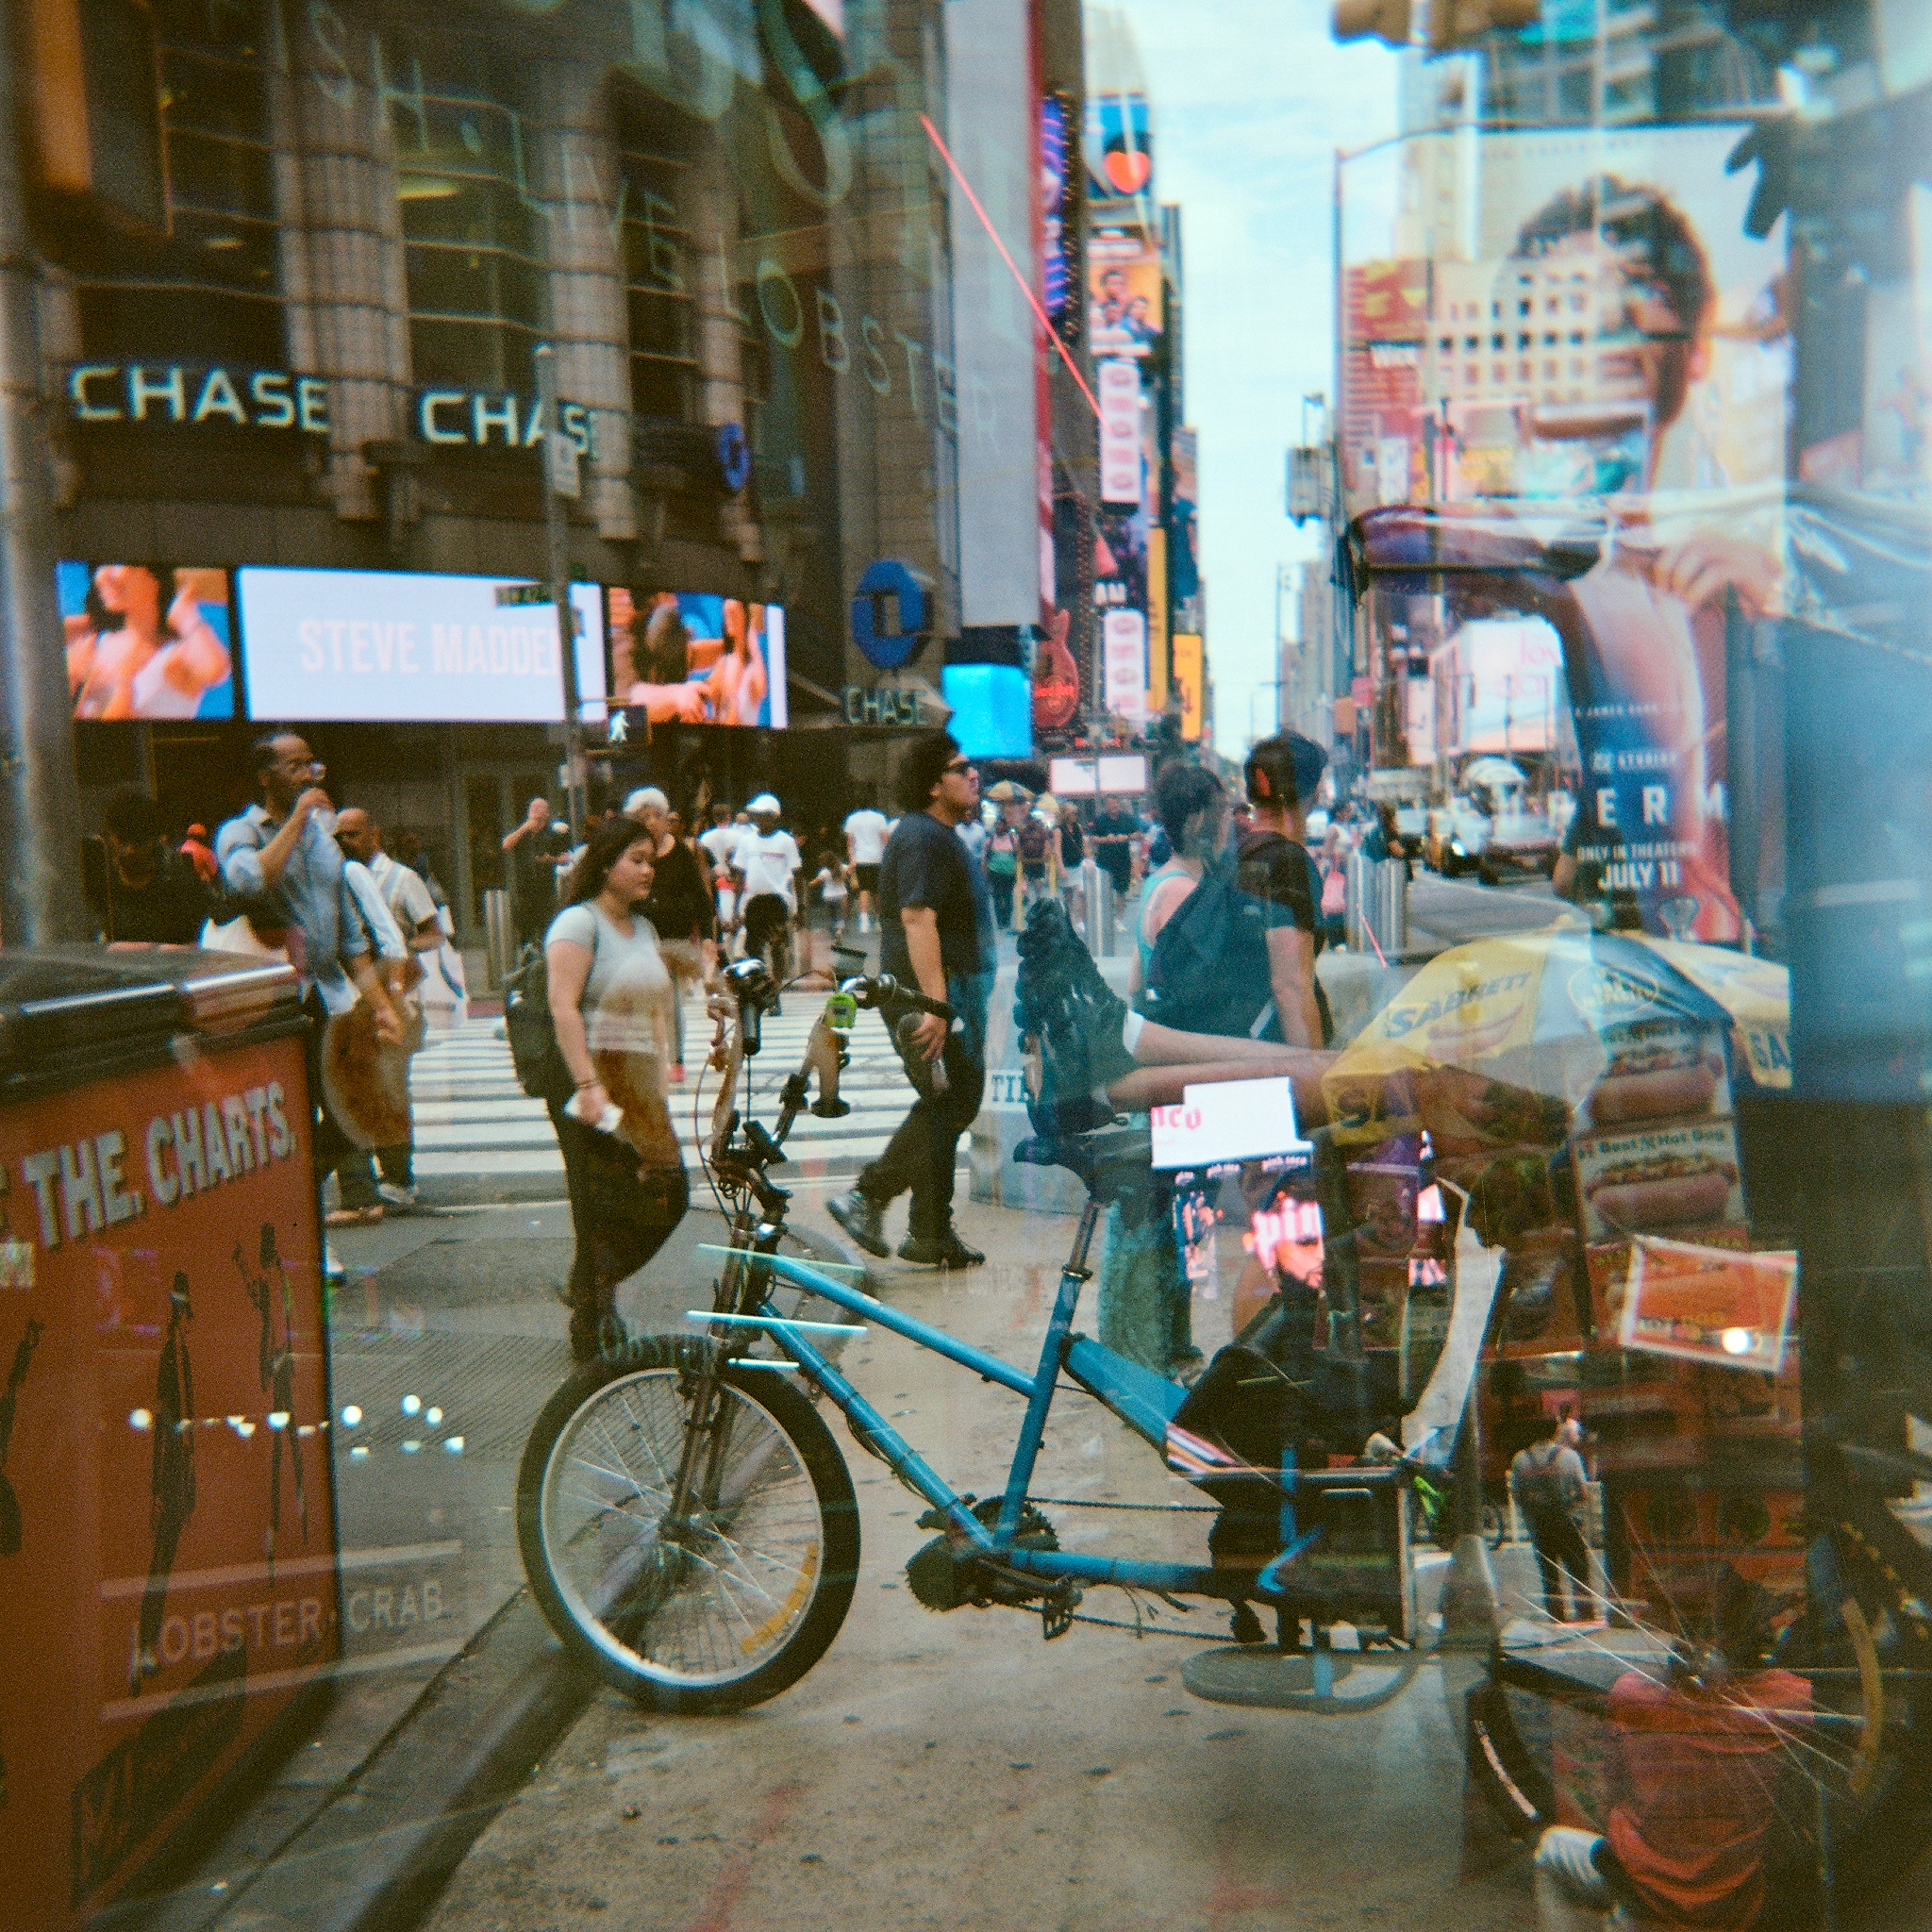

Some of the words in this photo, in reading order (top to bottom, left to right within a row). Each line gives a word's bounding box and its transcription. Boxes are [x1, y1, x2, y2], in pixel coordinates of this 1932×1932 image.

[70, 362, 329, 434] CHASE
[298, 618, 420, 674] STEVE
[841, 684, 928, 725] CHASE
[1597, 862, 1654, 890] JULY
[348, 1577, 448, 1634] CRAB
